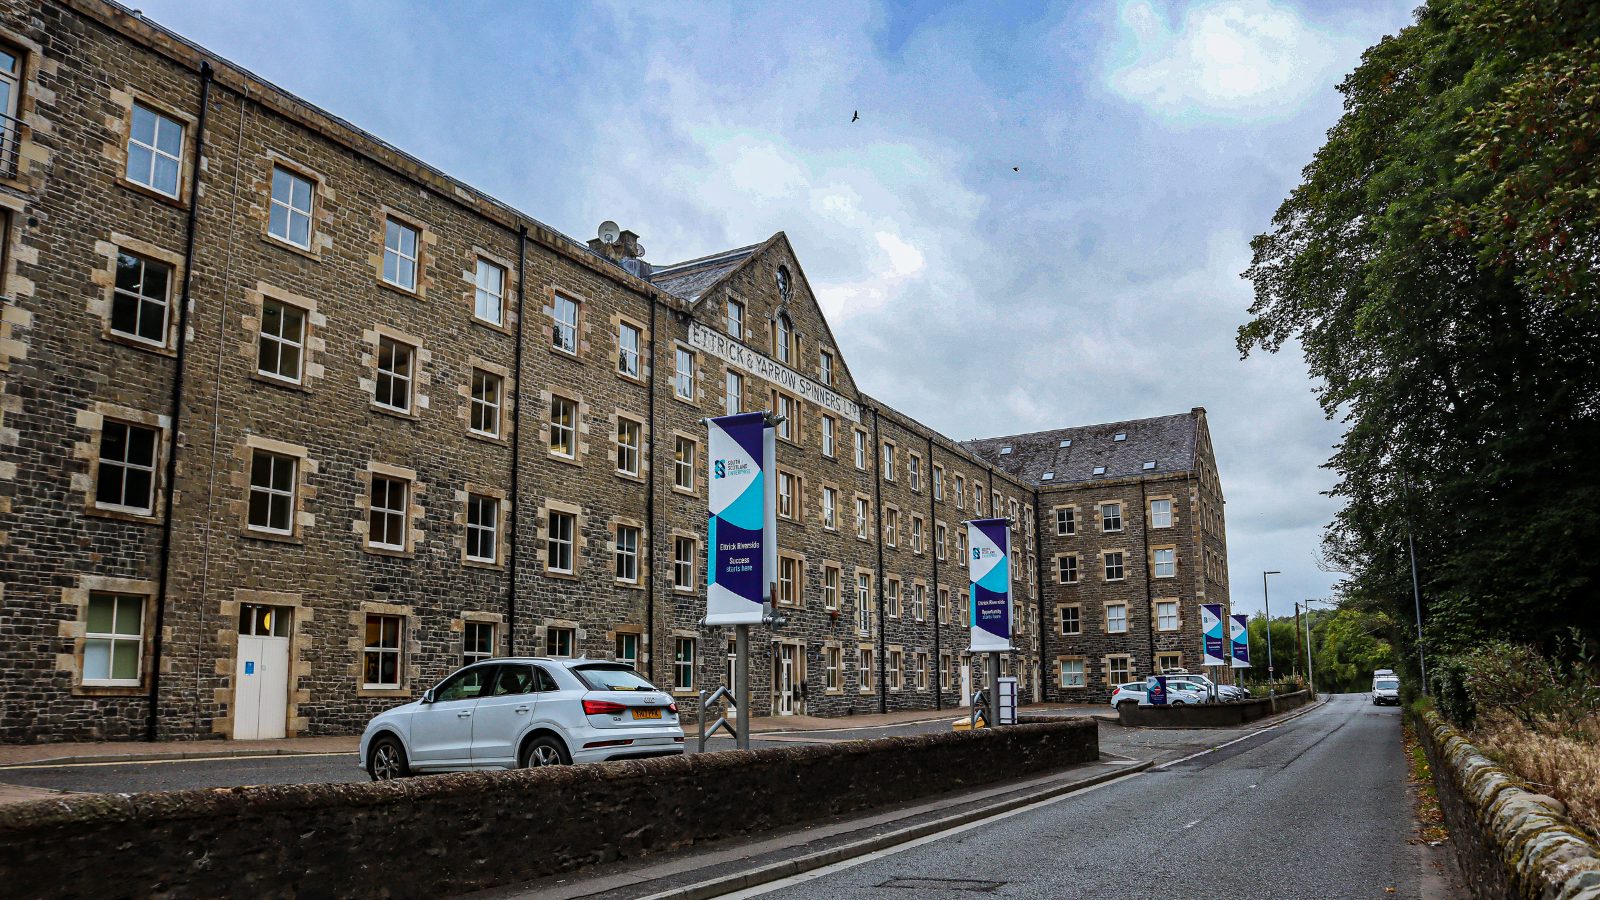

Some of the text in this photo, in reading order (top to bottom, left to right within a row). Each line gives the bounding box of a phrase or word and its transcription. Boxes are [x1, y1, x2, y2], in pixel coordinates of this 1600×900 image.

[693, 326, 744, 365] ETTRICK
[747, 354, 754, 369] &
[756, 357, 796, 390] YARROW
[799, 378, 841, 411] SPINNERS
[728, 463, 748, 471] SCOTLAND
[720, 541, 760, 551] Ettrick Riverside
[729, 557, 750, 565] Success
[726, 565, 741, 573] starts
